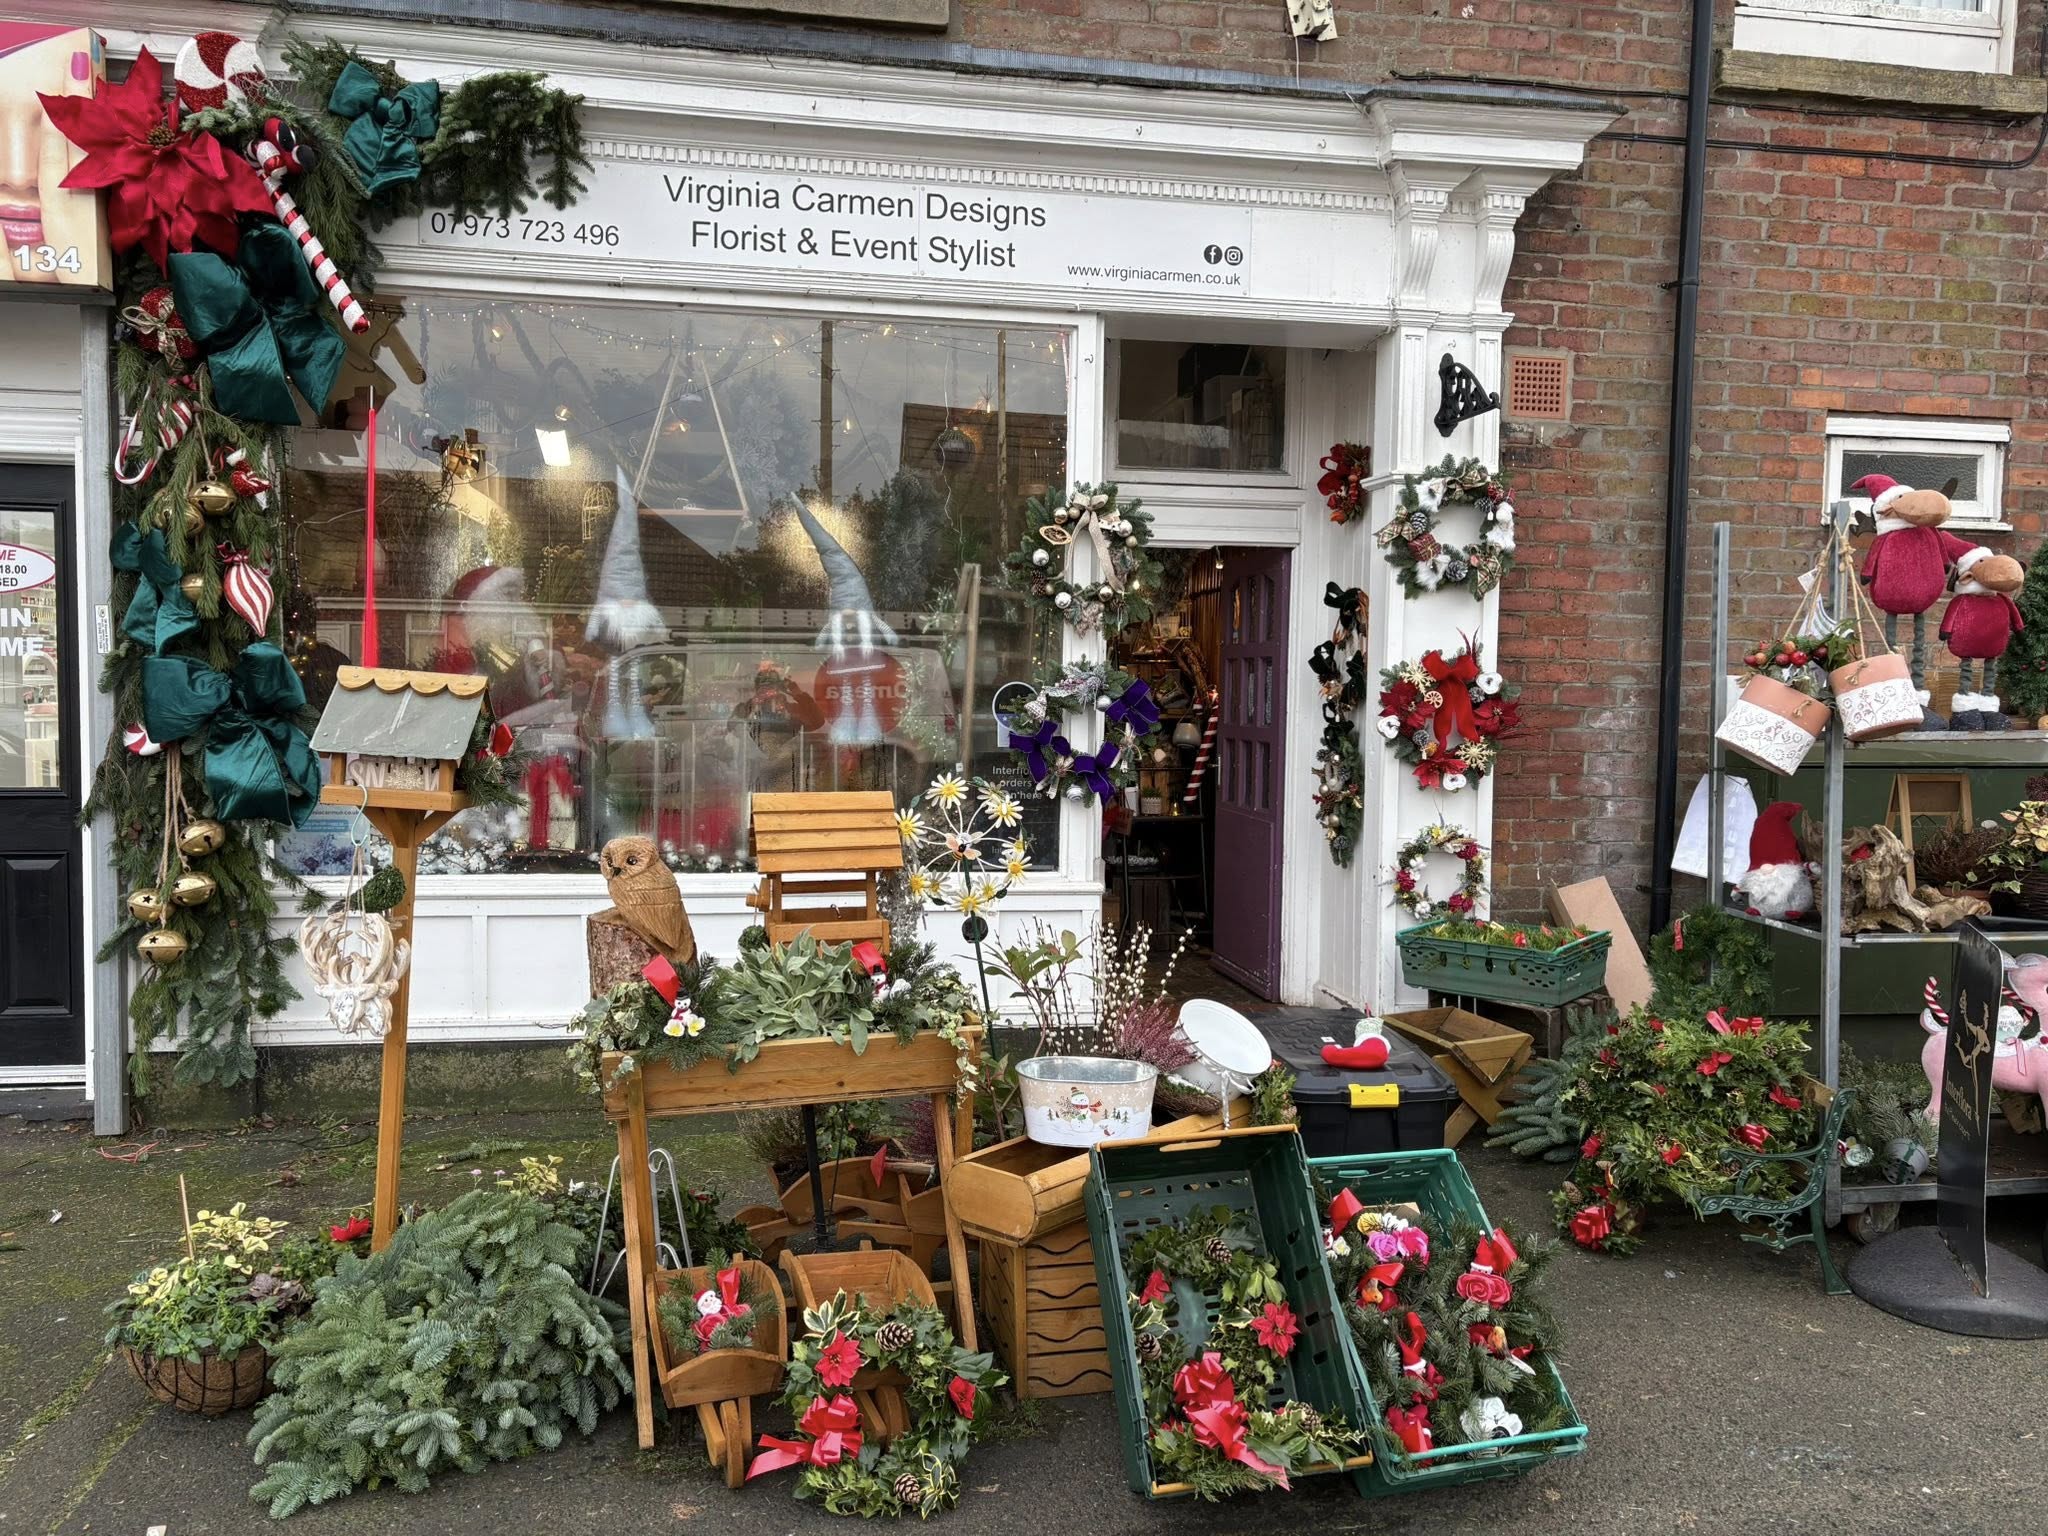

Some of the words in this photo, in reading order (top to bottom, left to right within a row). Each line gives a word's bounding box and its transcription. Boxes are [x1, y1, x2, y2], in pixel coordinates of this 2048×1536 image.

[663, 174, 780, 212] Virginia
[792, 183, 914, 219] Carmen
[926, 193, 1046, 231] Designs
[431, 212, 510, 239] 07973
[520, 219, 565, 243] 723
[573, 223, 620, 247] 496
[692, 221, 787, 254] Florist
[797, 227, 819, 256] &
[831, 230, 918, 262] Event
[928, 235, 1016, 271] Stylist
[13, 244, 81, 273] 134
[1067, 265, 1241, 285] www.virginiacarmen.co.uk
[0, 608, 32, 627] IN
[992, 766, 1029, 775] Interflo
[1000, 779, 1032, 787] orders
